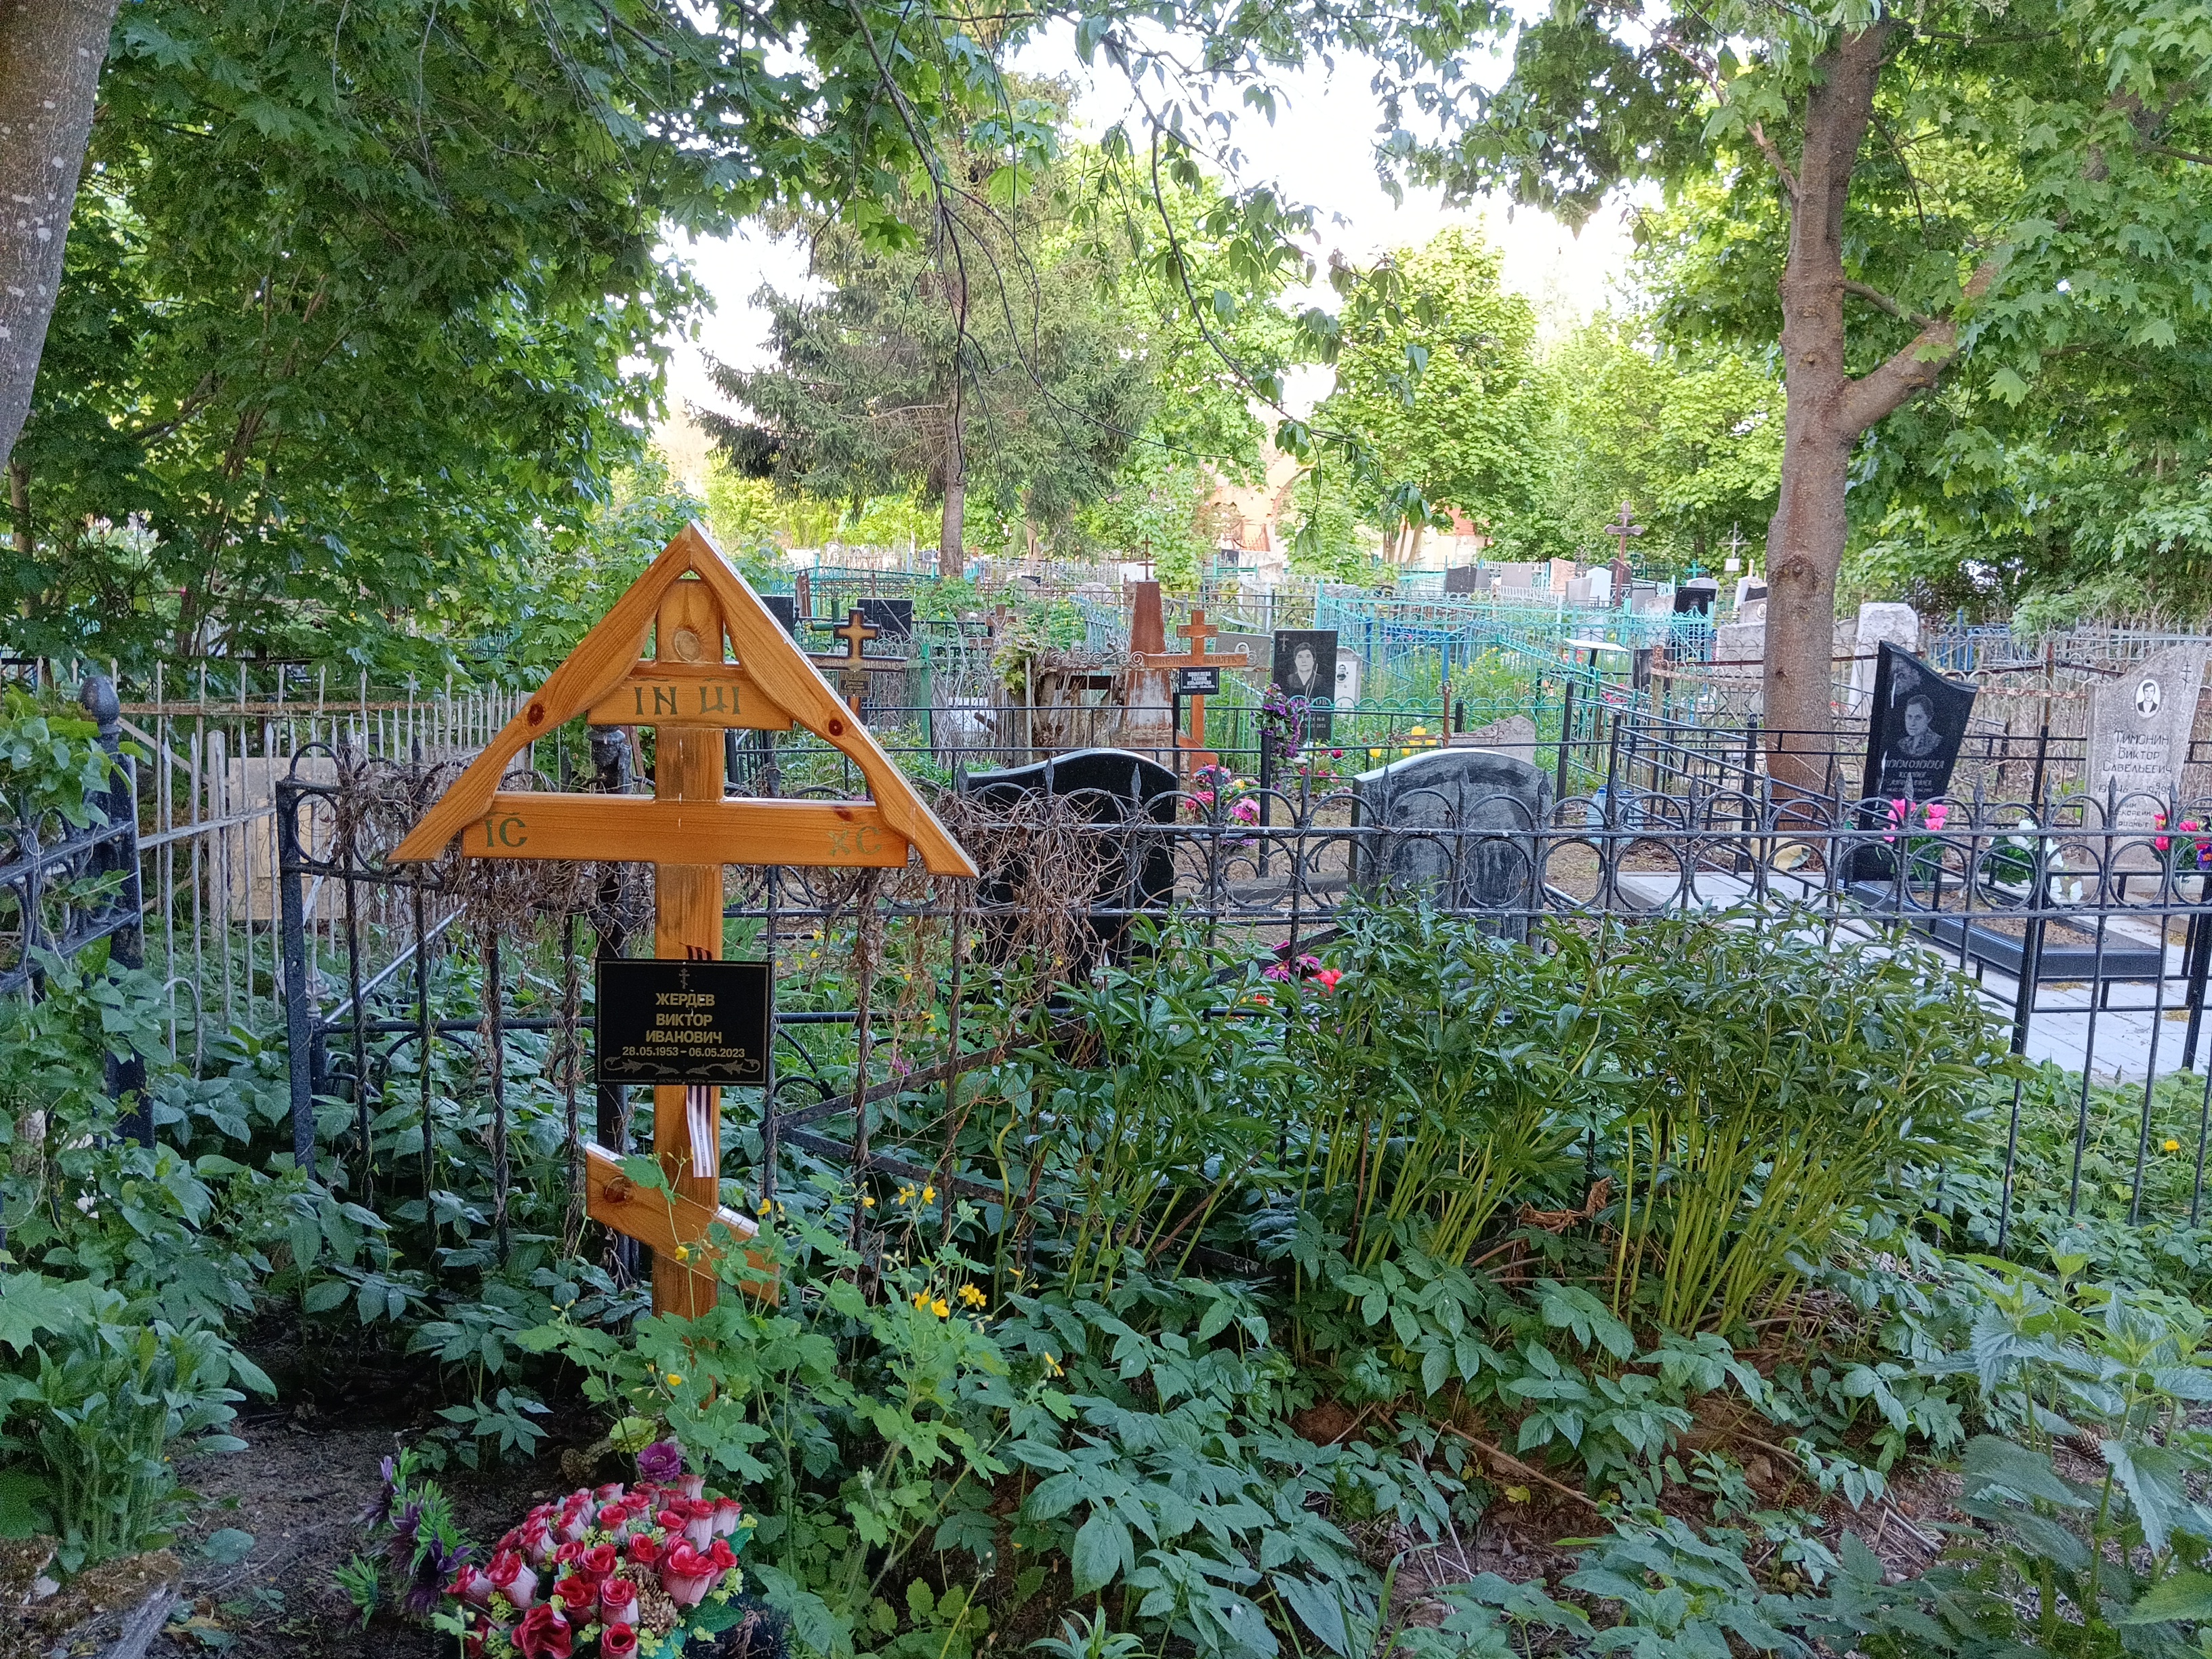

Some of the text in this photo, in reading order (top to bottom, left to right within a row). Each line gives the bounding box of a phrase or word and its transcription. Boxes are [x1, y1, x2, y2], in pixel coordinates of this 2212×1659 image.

[655, 993, 715, 1008] ЖЕРДЕВ
[656, 1013, 713, 1026] ВИКТОР
[646, 1030, 722, 1044] ИВАНОВИЧ
